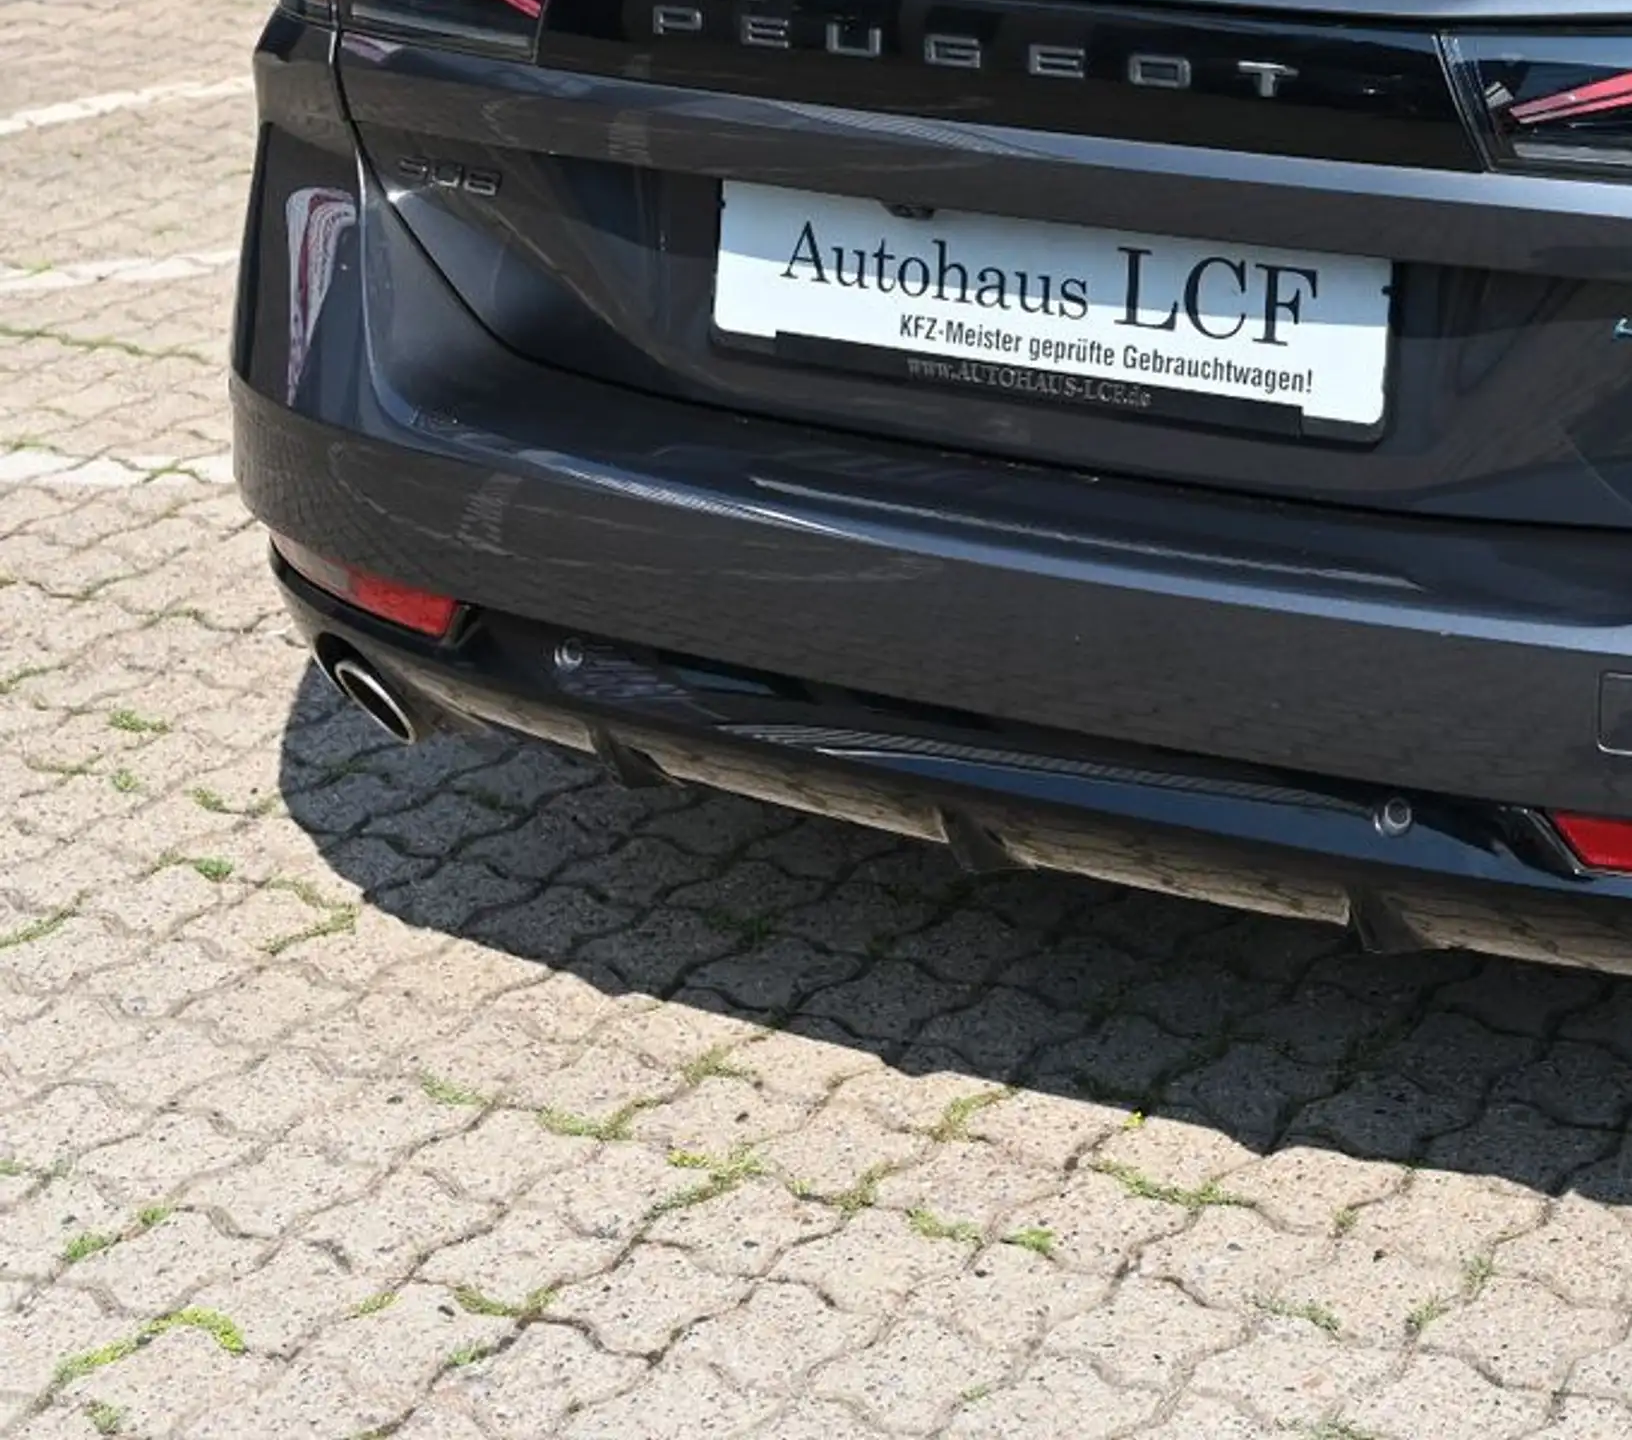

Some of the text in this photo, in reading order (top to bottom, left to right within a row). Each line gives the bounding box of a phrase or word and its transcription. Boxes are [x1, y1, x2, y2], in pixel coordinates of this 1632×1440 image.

[652, 4, 1299, 98] PEUGEOT
[780, 220, 1318, 347] Autohaus LCF
[899, 313, 1313, 395] KFZ-Meister geprüfte Gebrauchtwagen!
